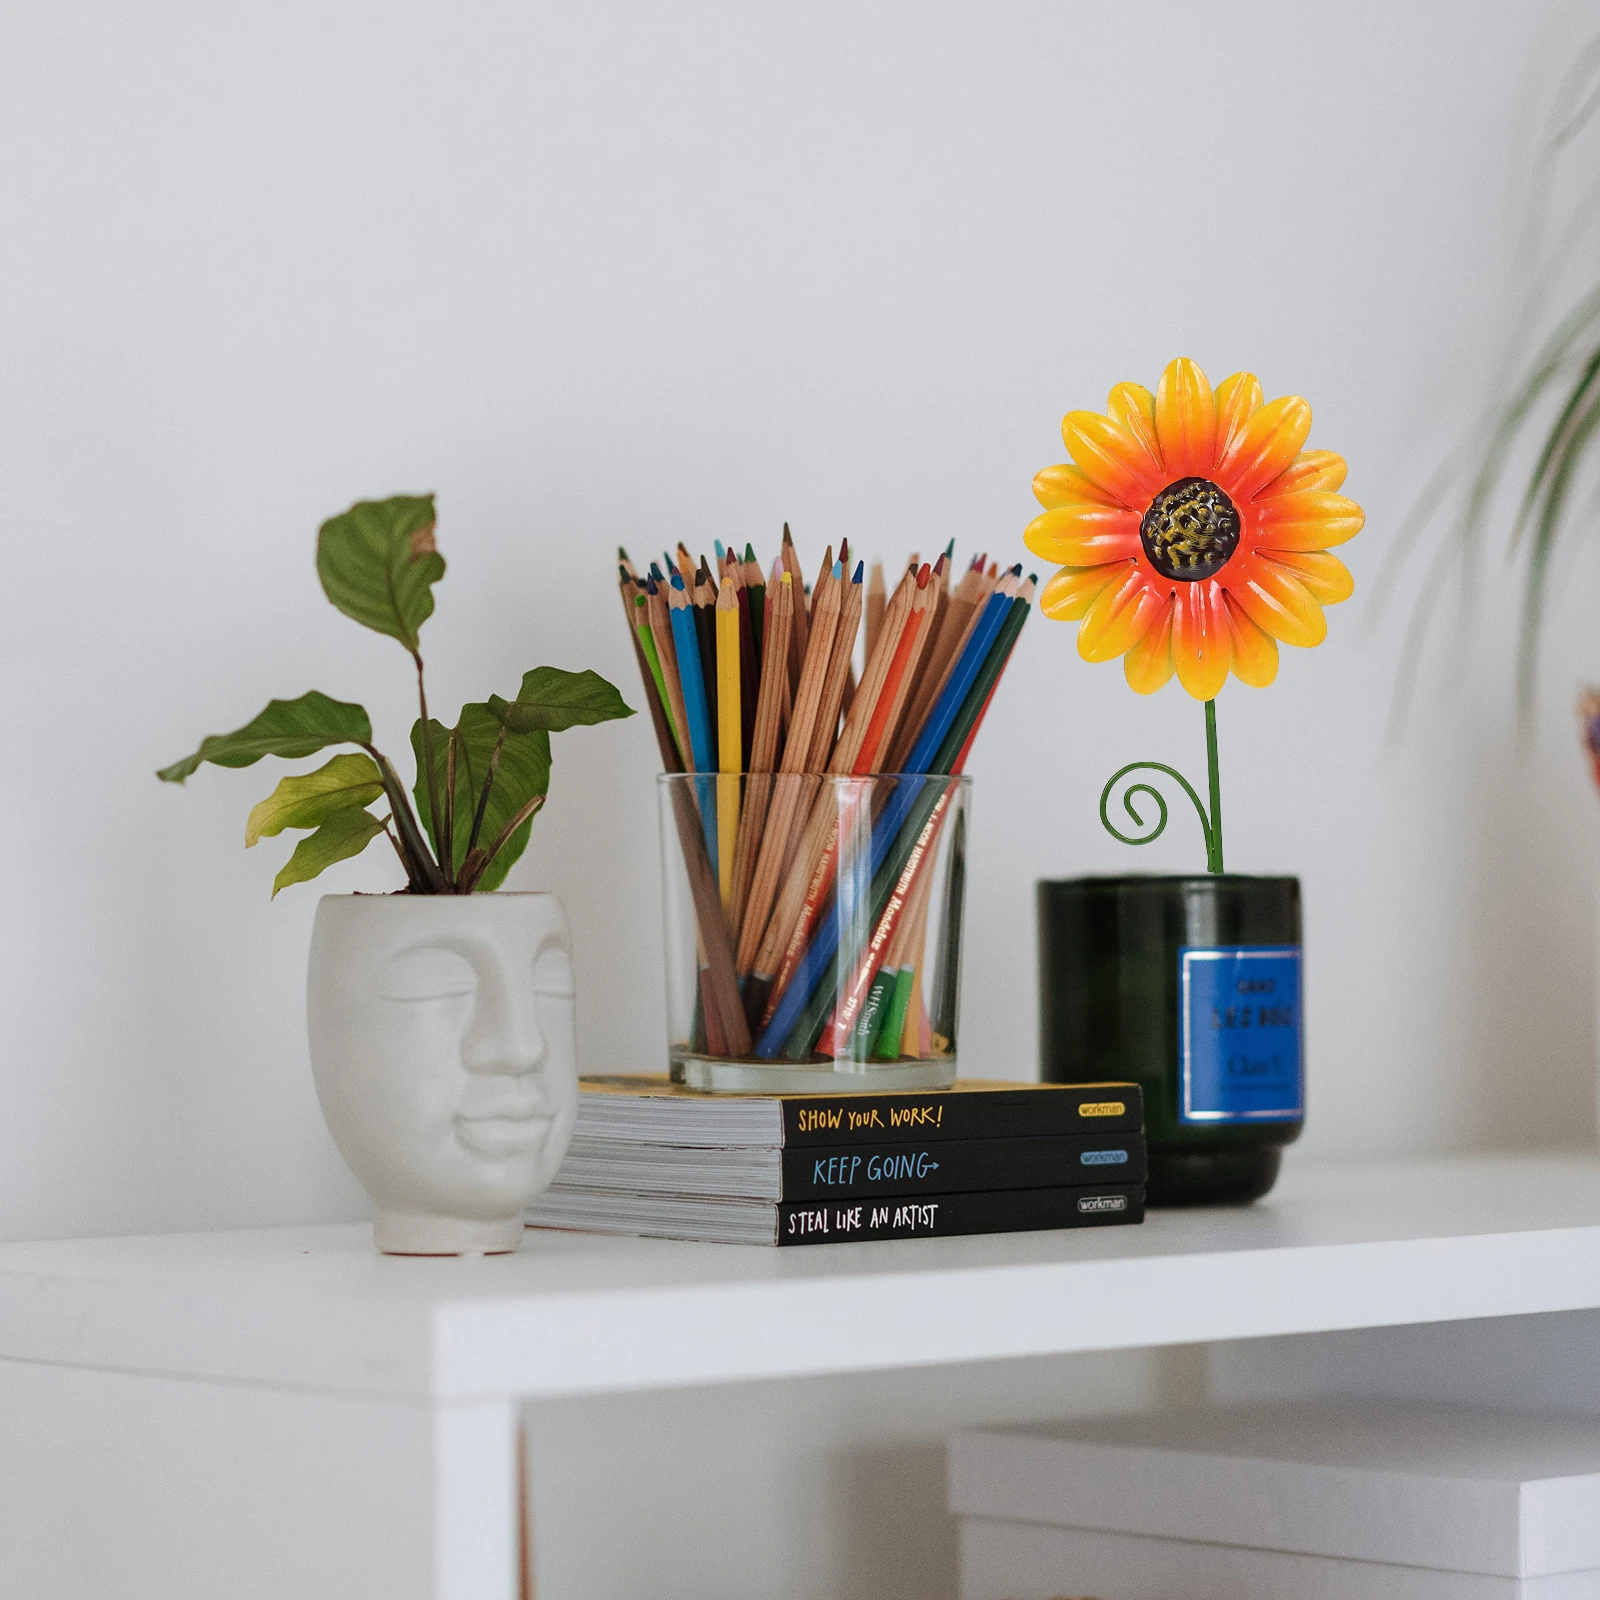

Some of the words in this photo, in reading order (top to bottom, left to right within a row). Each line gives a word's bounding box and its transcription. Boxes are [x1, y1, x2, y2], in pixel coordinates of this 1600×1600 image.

[895, 844, 924, 895] HARDTMUTH
[786, 903, 813, 957] Mondeluz
[871, 895, 902, 950] Mondeluz
[857, 985, 884, 1036] WHSmith
[798, 1108, 843, 1131] SHOW
[848, 1109, 885, 1130] YOUR
[890, 1105, 943, 1128] WORK!
[1081, 1103, 1123, 1115] workman
[813, 1156, 862, 1185] KEEP
[867, 1152, 930, 1180] GOING
[1083, 1151, 1126, 1163] workman
[788, 1208, 829, 1235] STEAL
[836, 1206, 862, 1232] LIKE
[870, 1206, 888, 1228] AN
[893, 1204, 938, 1230] ARTIST
[1080, 1197, 1124, 1210] workman
